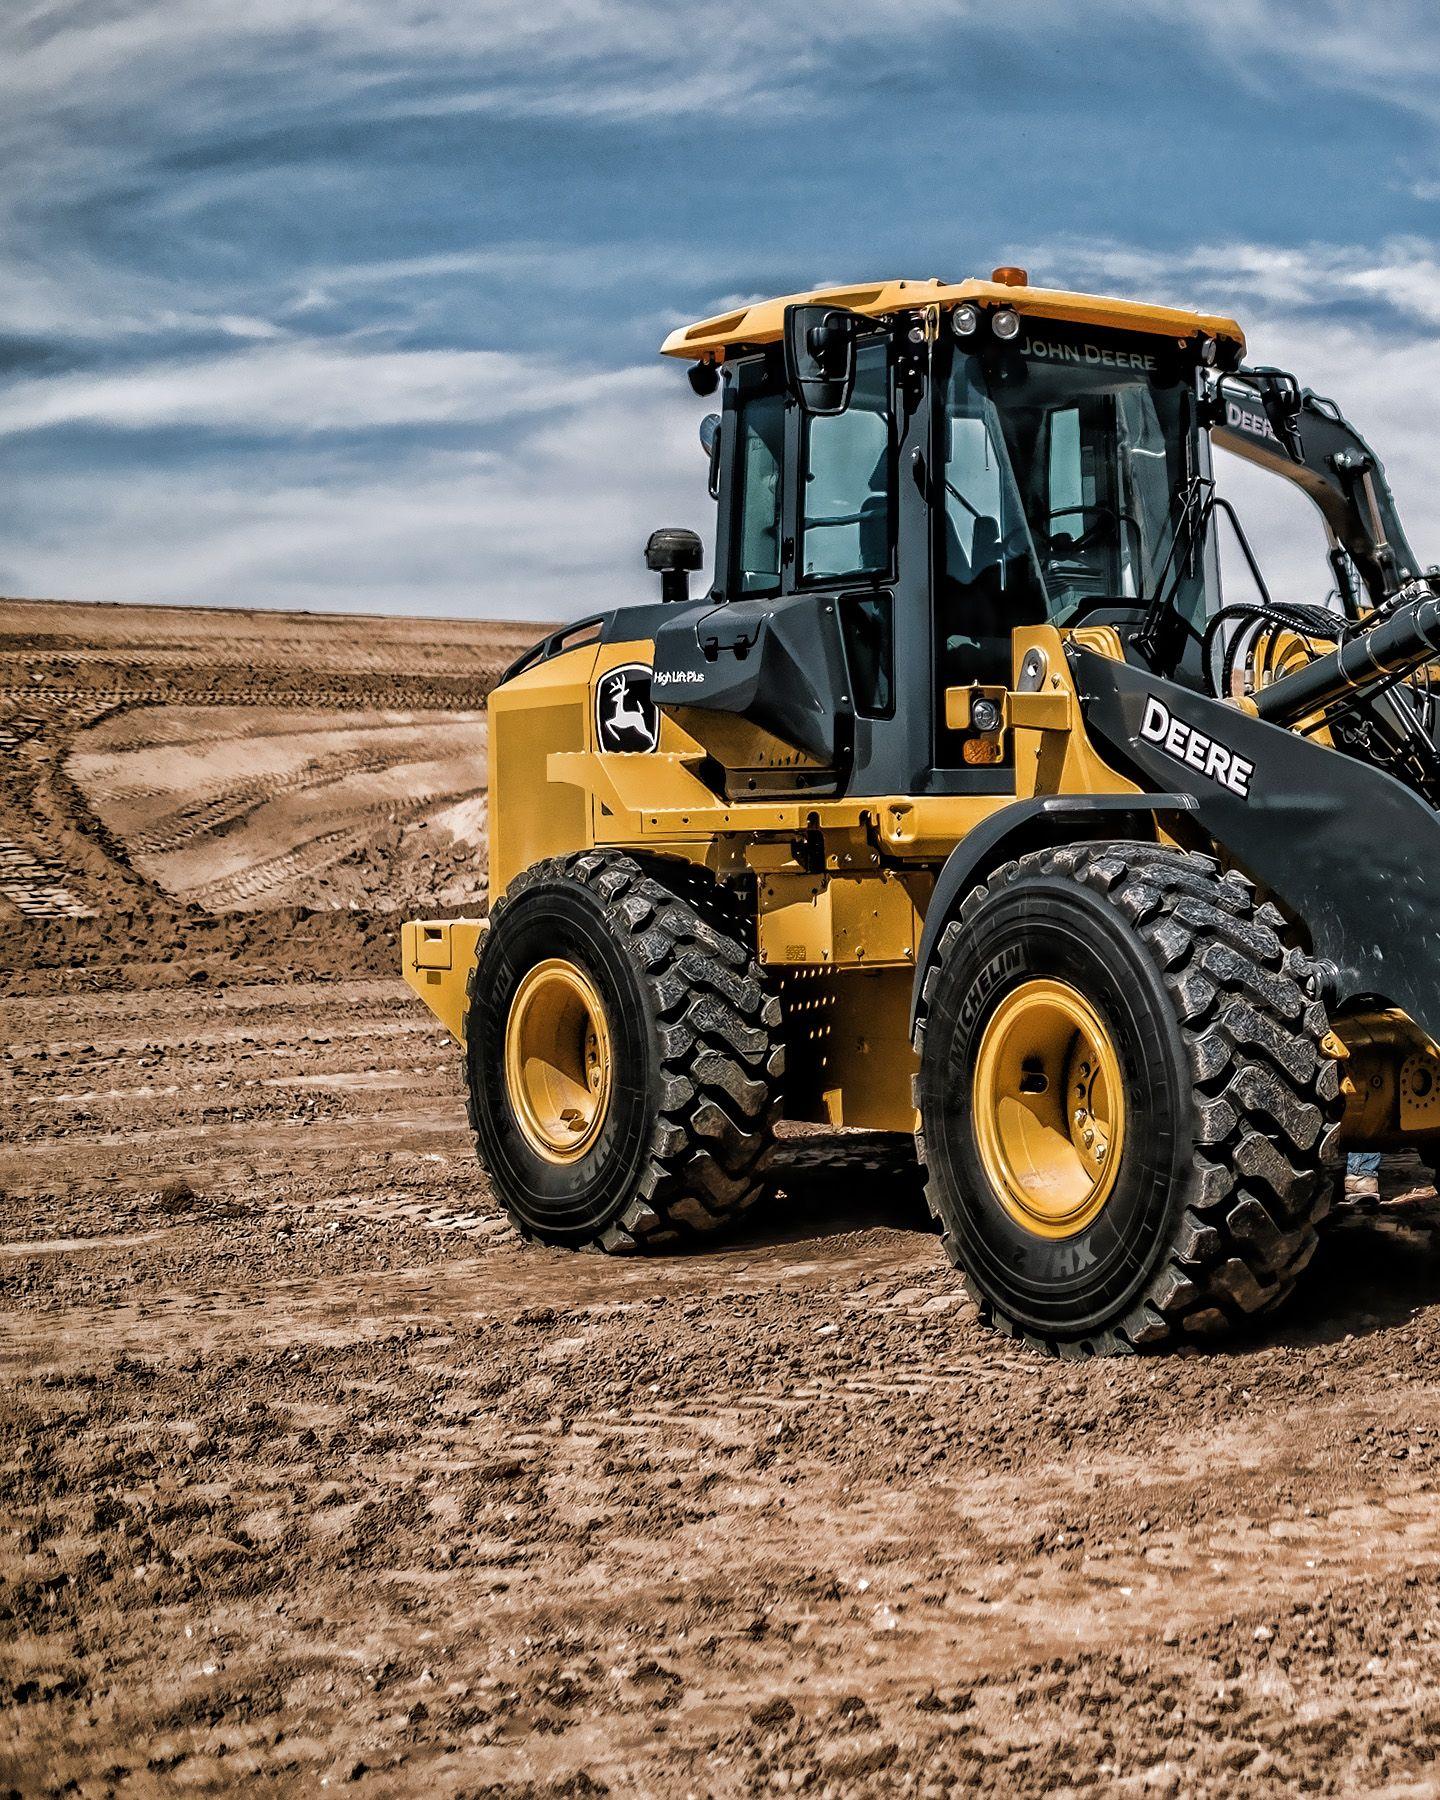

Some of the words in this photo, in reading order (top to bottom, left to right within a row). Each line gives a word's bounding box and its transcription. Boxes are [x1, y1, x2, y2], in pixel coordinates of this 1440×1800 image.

[1020, 337, 1080, 362] JOHN
[1084, 343, 1158, 371] DEERE
[654, 671, 671, 686] High
[672, 671, 687, 683] Lift
[687, 671, 705, 683] Plus
[1140, 696, 1254, 798] DEERE
[949, 943, 1027, 1074] MICHELIN
